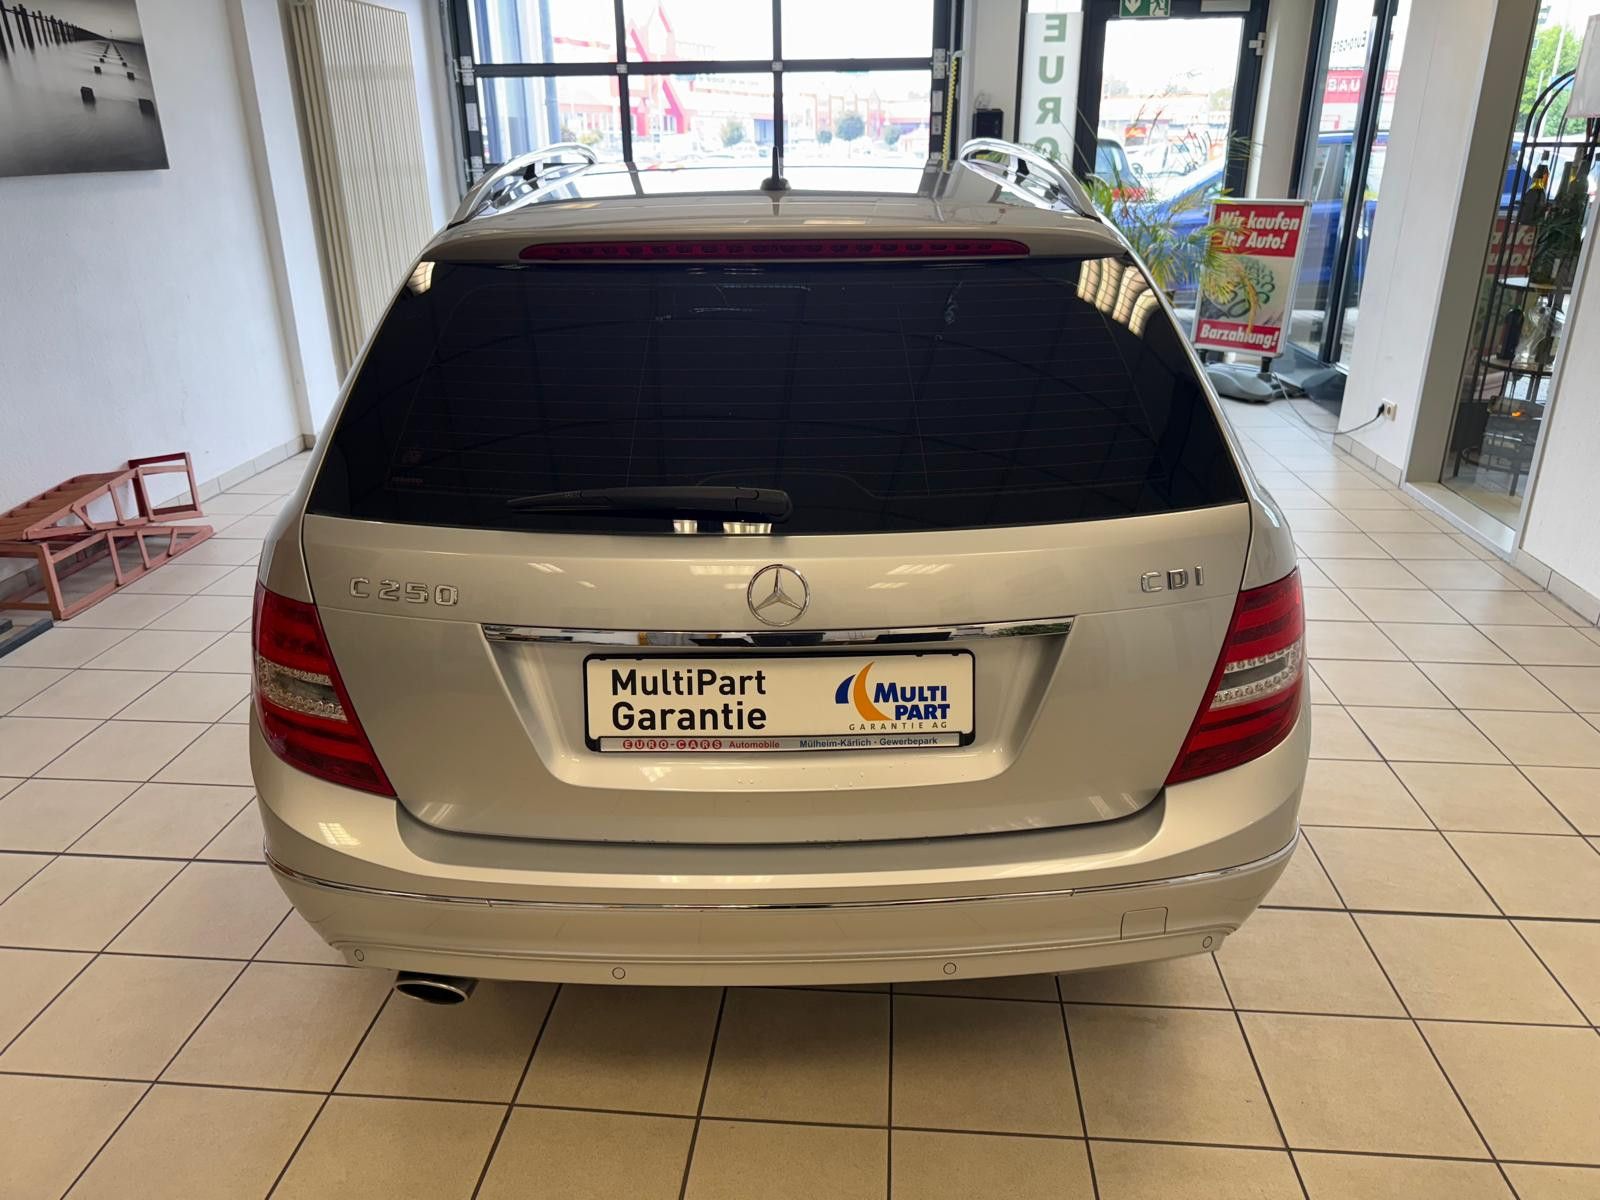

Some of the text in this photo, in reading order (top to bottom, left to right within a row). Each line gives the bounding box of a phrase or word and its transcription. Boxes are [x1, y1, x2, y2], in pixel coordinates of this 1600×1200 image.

[1219, 210, 1300, 231] Wir kaufen
[1222, 230, 1289, 250] Ihr Auto!
[1200, 323, 1280, 349] Barzahlung!
[1141, 565, 1204, 593] CDI
[349, 576, 459, 606] C 250
[611, 668, 766, 696] MultiPart
[873, 682, 947, 703] MULTI
[612, 701, 767, 731] Garantie
[895, 703, 950, 720] PART
[848, 720, 948, 731] GARANTIE AG
[622, 736, 938, 750] EURO-CARS Automobile Mülheim-Kärlich Gewerbepark
